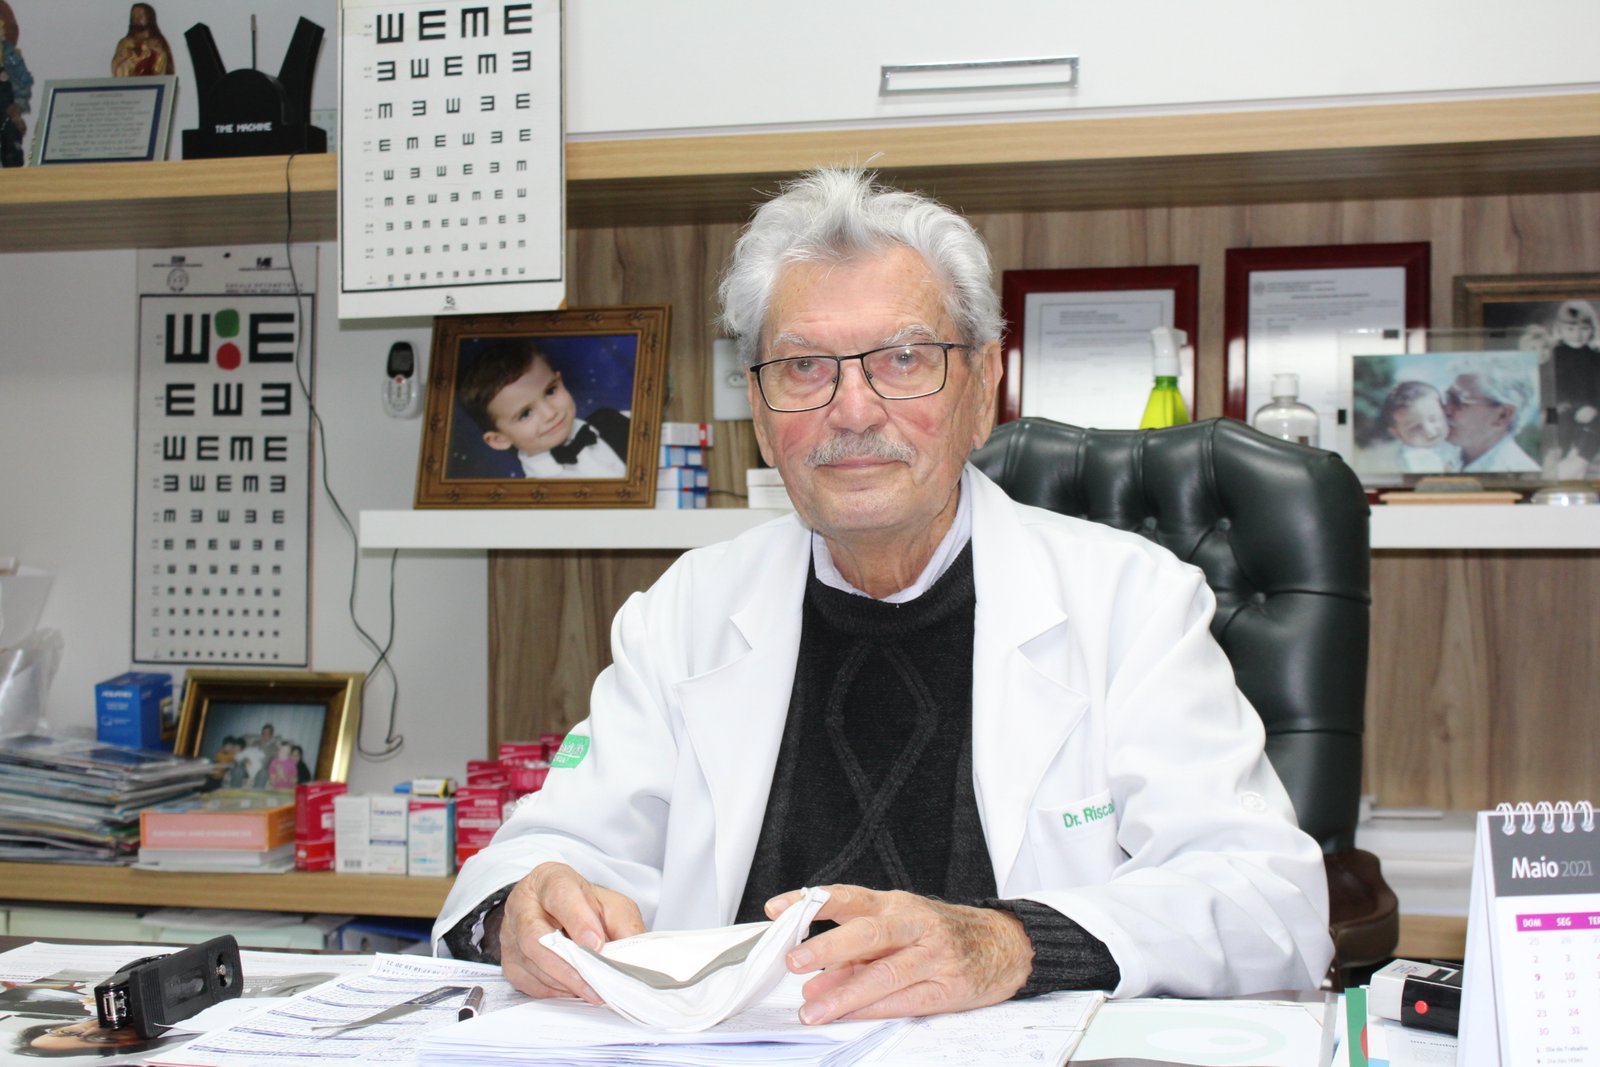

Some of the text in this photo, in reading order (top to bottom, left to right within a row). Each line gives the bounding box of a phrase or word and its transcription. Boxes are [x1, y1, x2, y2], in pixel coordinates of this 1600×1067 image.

[215, 121, 272, 134] TIME MACHINE
[1062, 812, 1082, 828] Dr.
[1511, 855, 1594, 879] Maio 2021
[1522, 918, 1542, 928] DOM
[1556, 916, 1572, 927] SEG
